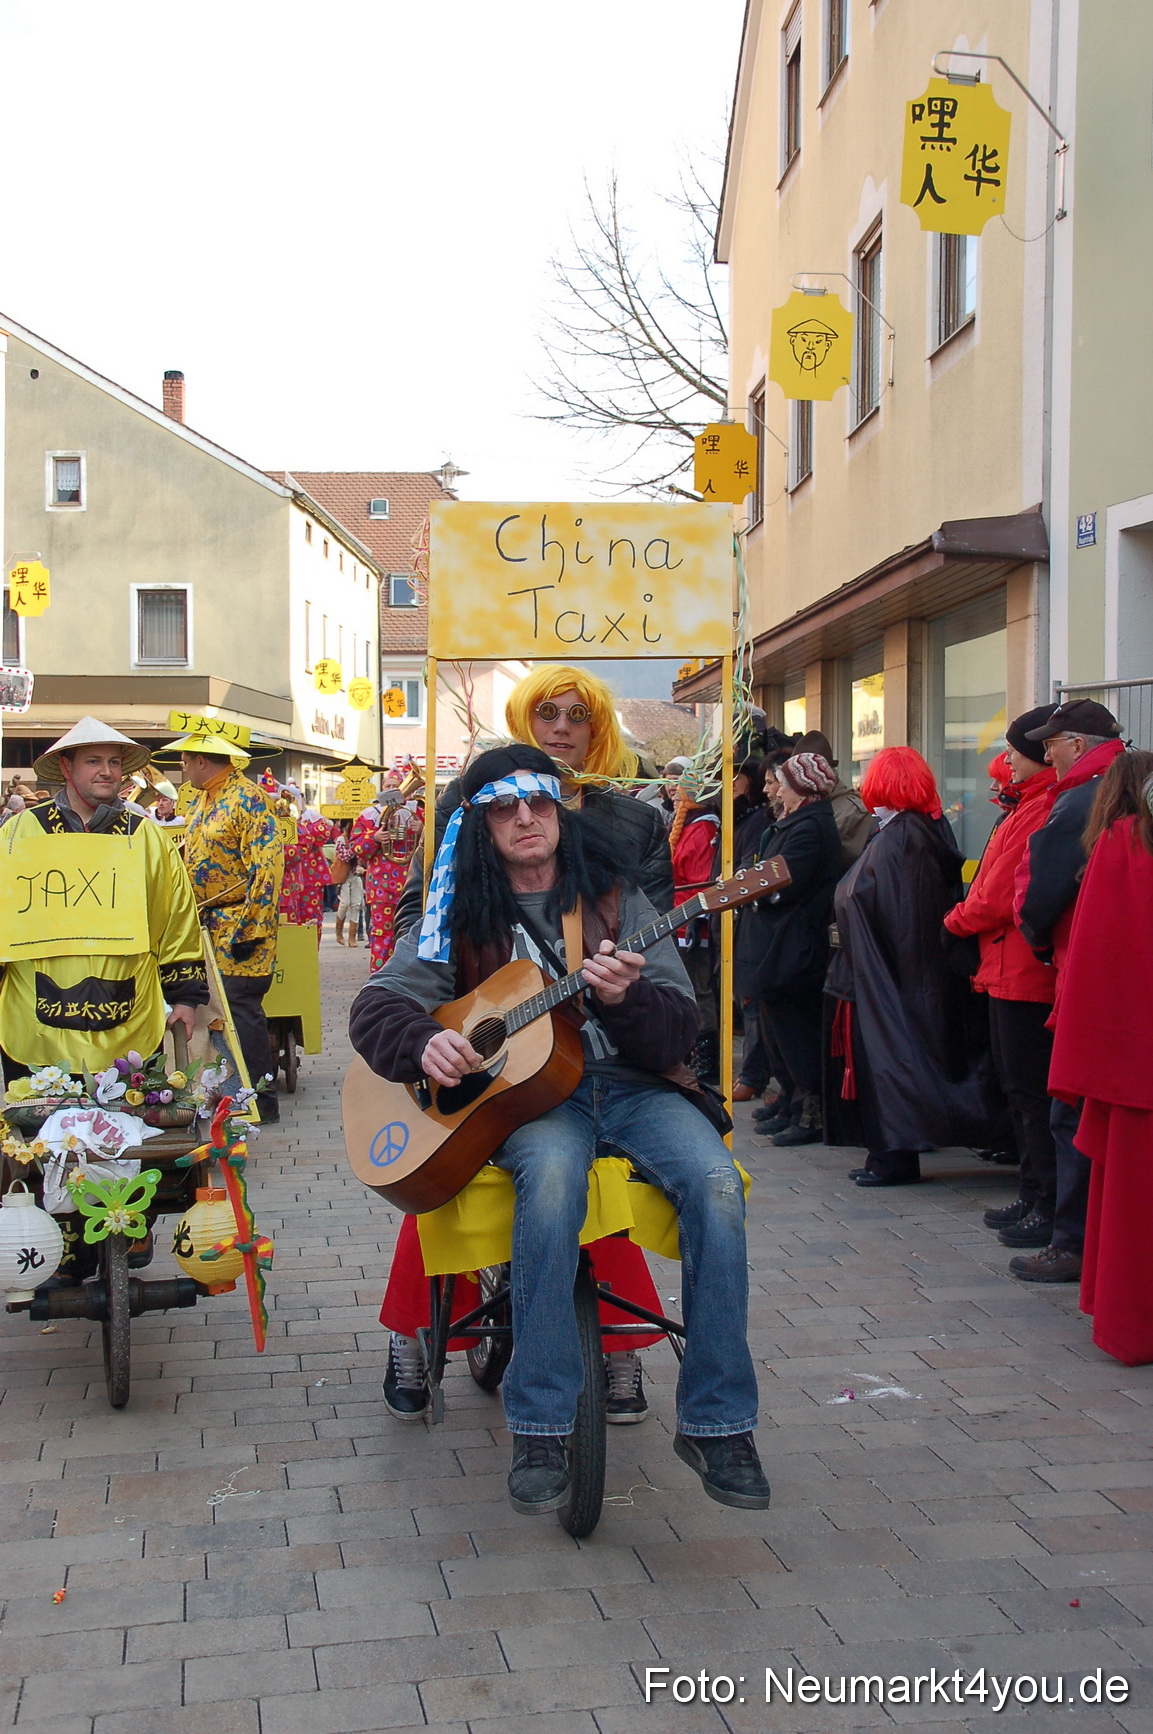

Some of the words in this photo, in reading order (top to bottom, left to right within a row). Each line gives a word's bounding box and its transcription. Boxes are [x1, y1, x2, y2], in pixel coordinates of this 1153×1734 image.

[495, 514, 683, 583] China
[1079, 514, 1093, 532] 42
[508, 585, 662, 643] Taxi
